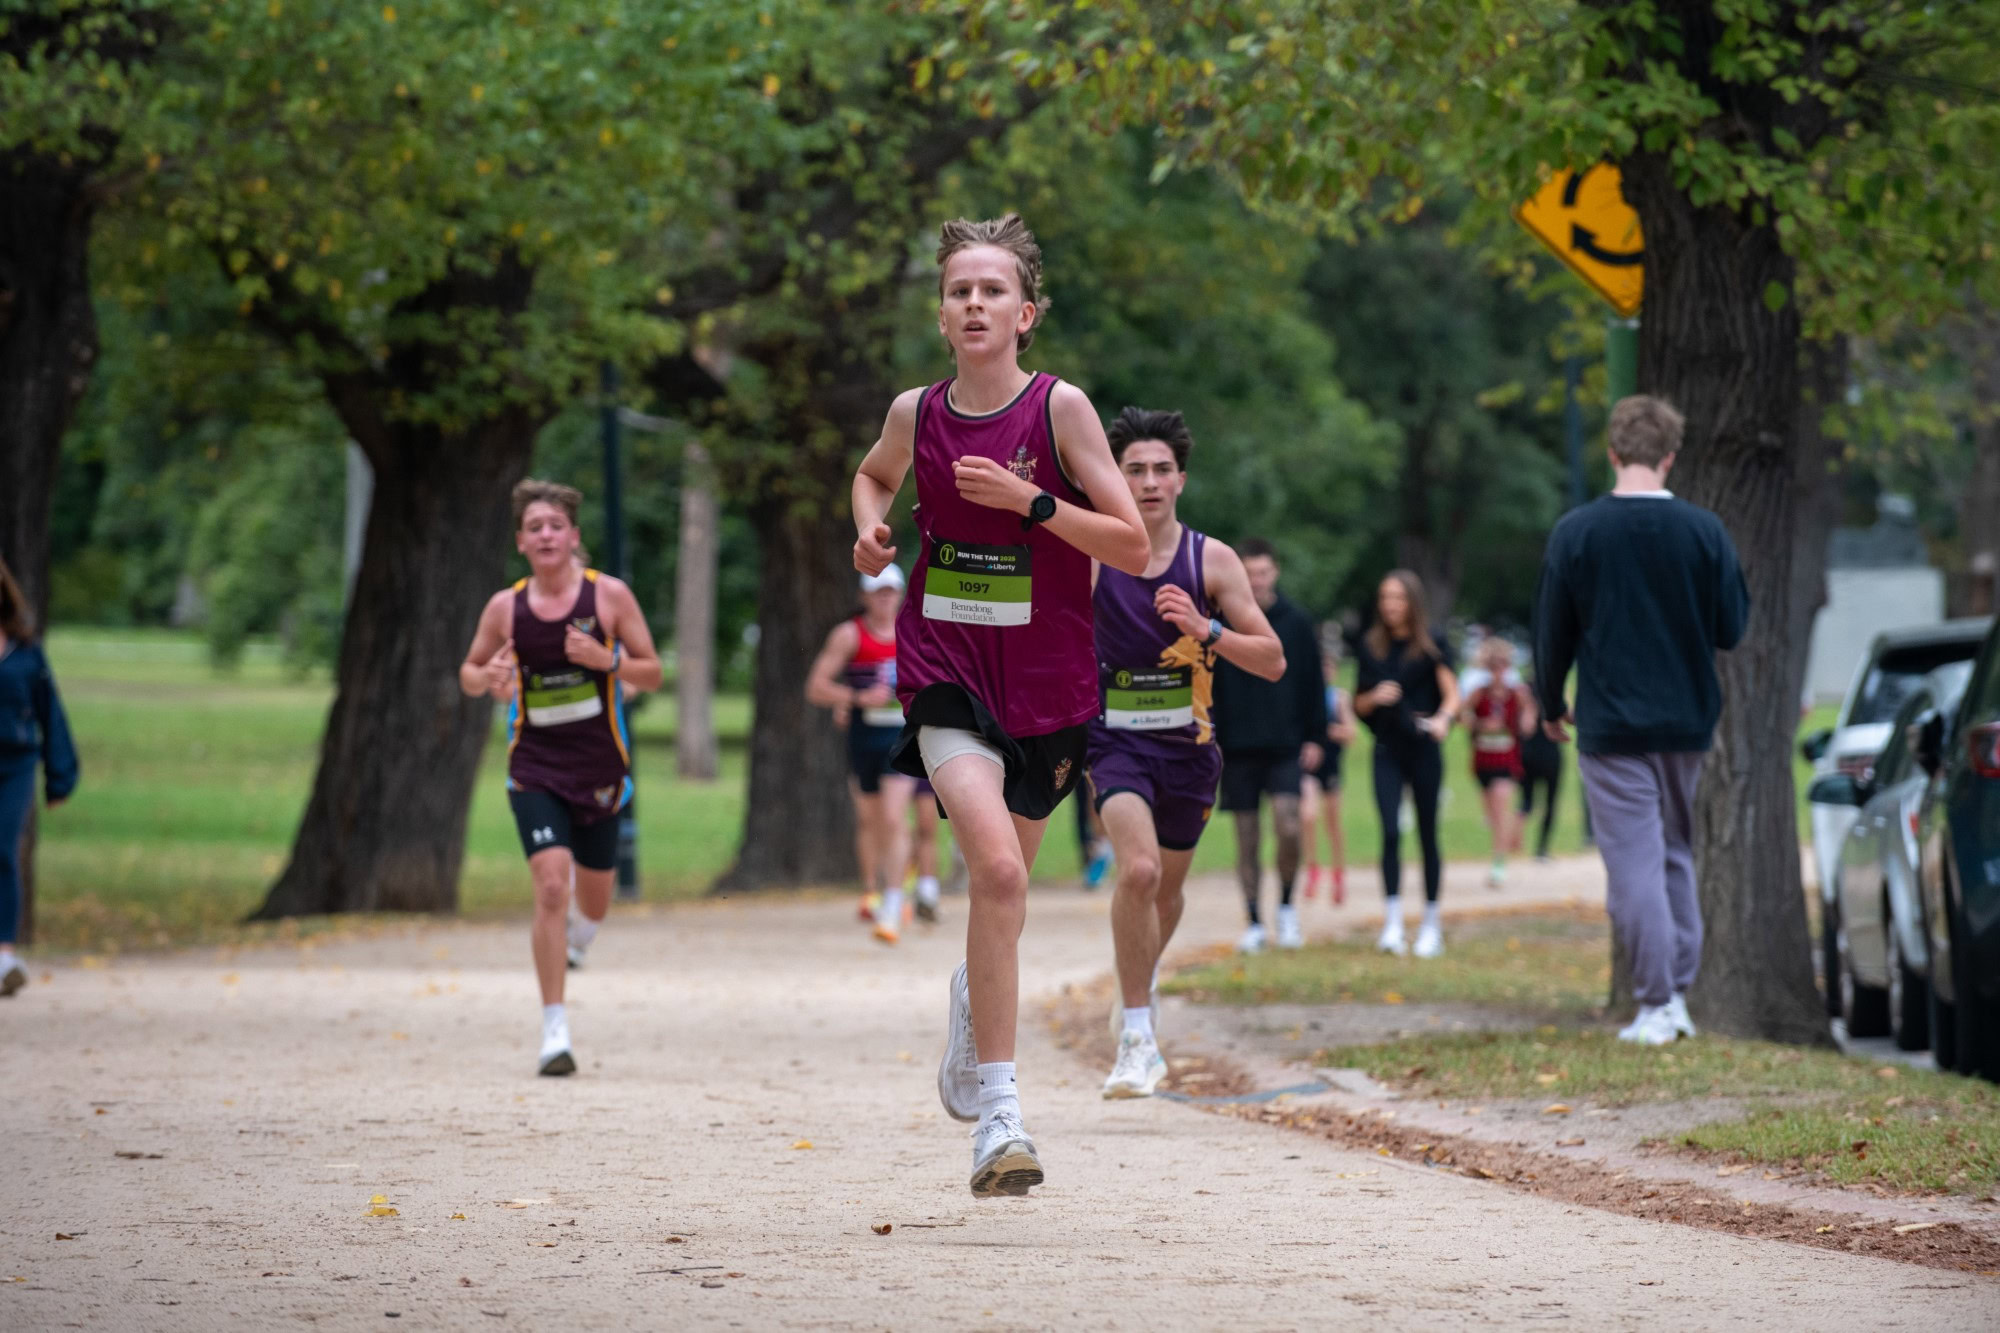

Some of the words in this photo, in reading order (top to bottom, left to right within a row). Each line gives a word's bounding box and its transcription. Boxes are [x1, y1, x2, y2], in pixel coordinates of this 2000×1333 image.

[944, 547, 953, 561] T
[993, 563, 1016, 571] Liberty
[958, 580, 990, 594] 1097
[951, 601, 993, 615] Bennelong
[1140, 715, 1170, 724] Liberty
